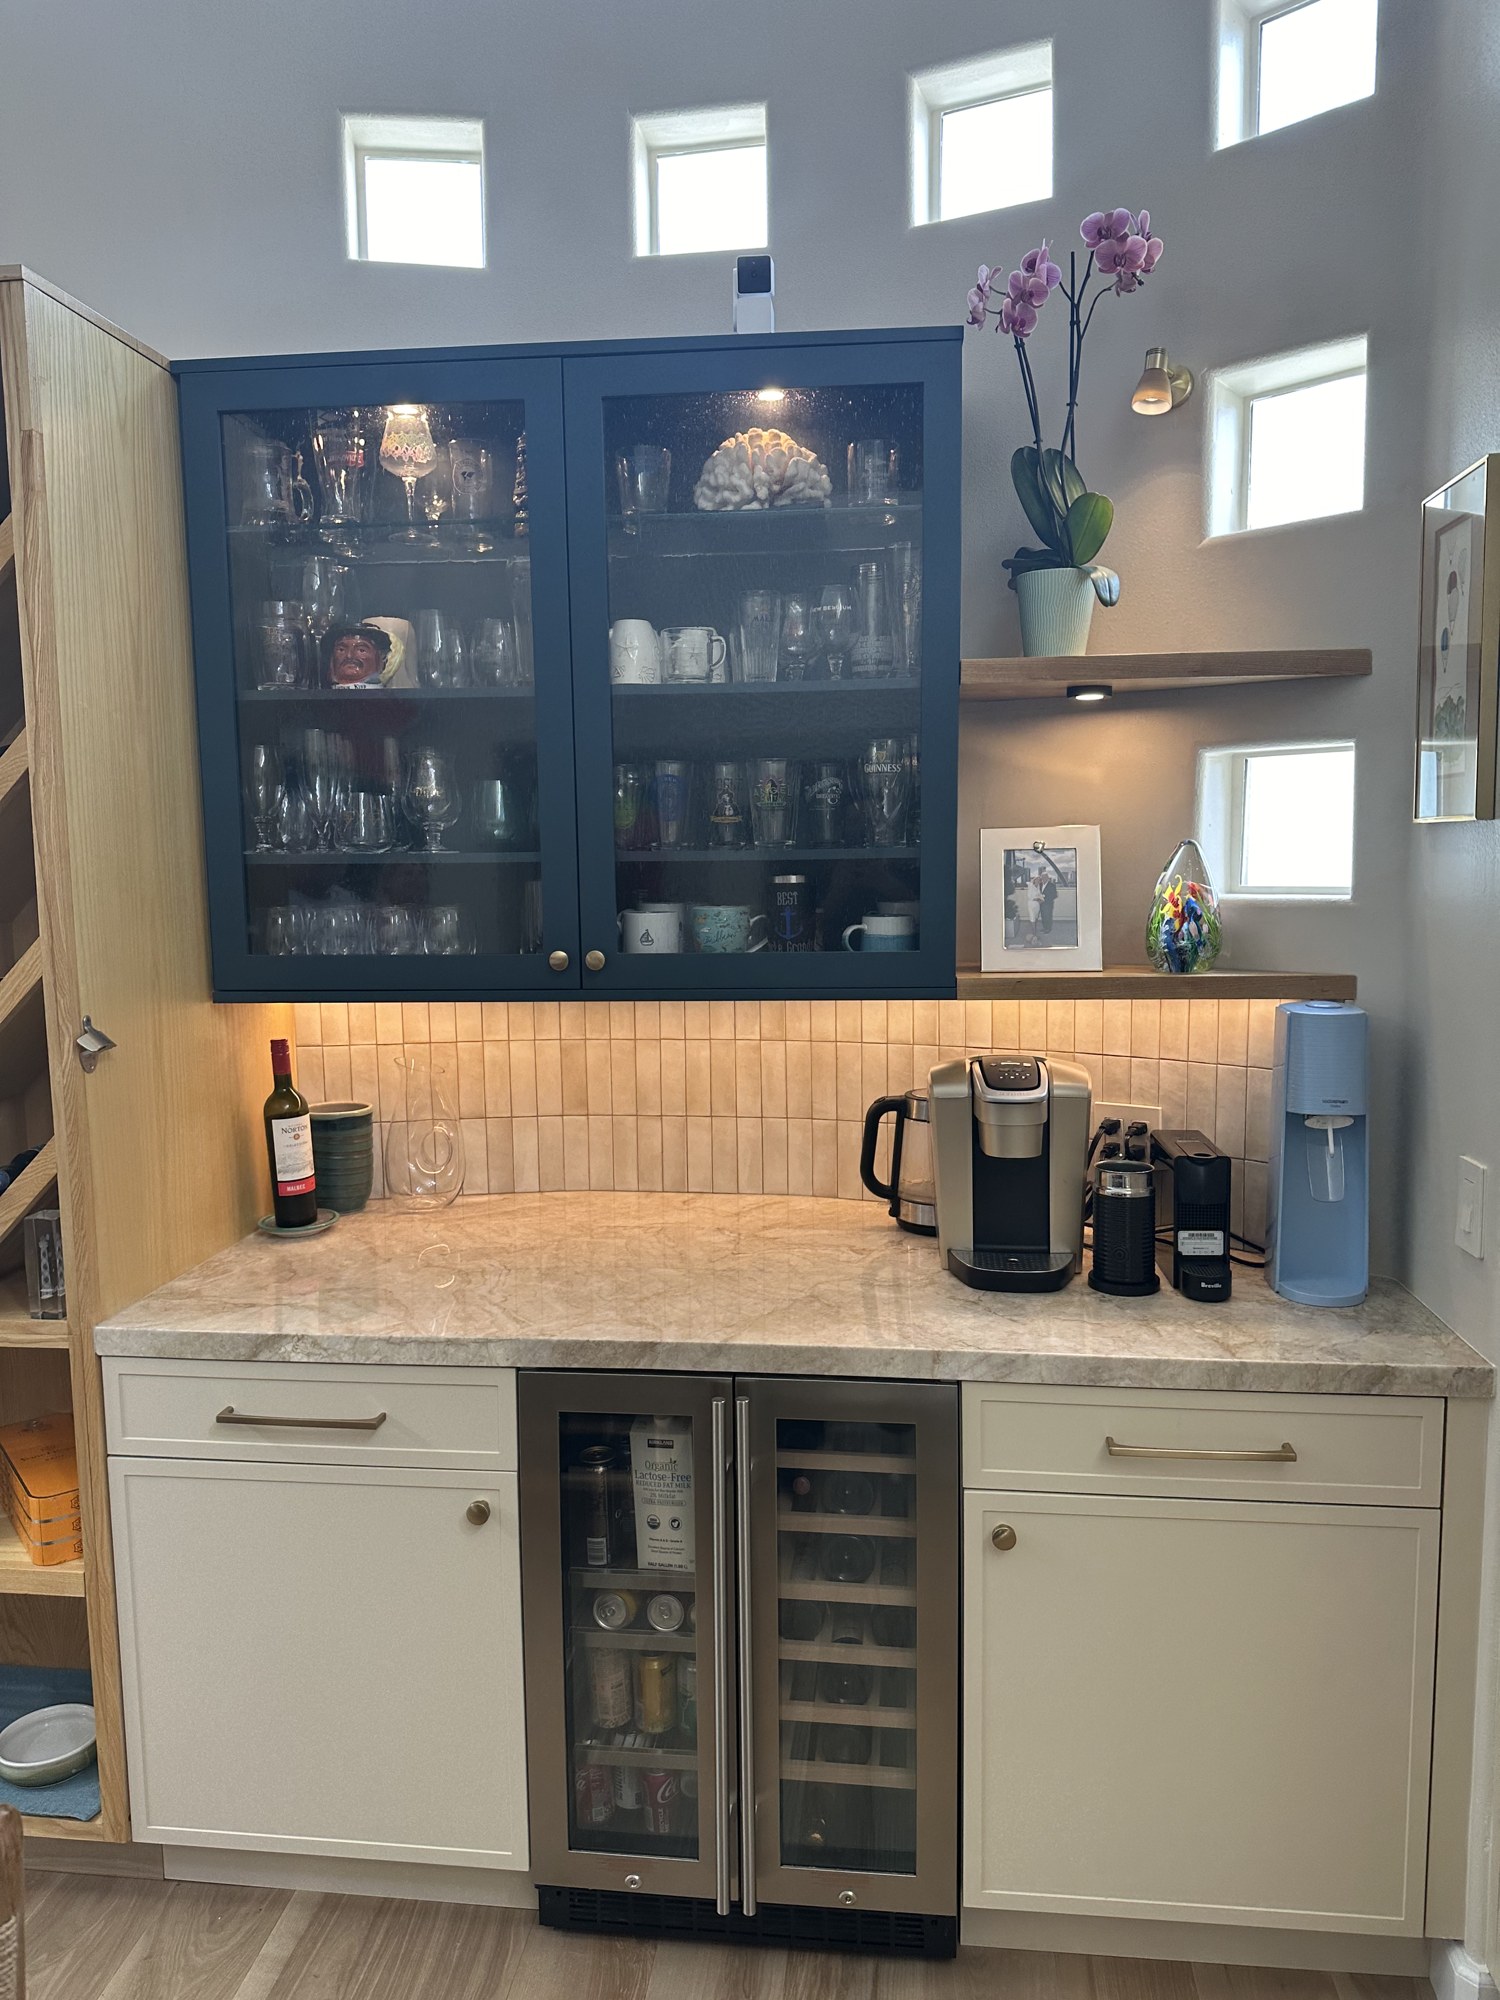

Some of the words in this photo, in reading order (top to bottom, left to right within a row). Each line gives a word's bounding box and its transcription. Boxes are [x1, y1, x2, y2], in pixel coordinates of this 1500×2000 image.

[863, 762, 902, 773] GUINNESS
[776, 891, 799, 906] BEST
[286, 1183, 306, 1192] MALBEC
[644, 1460, 679, 1472] Organic
[634, 1469, 692, 1482] Lactose-Free
[635, 1480, 662, 1488] REDUCED
[662, 1481, 674, 1489] FAT
